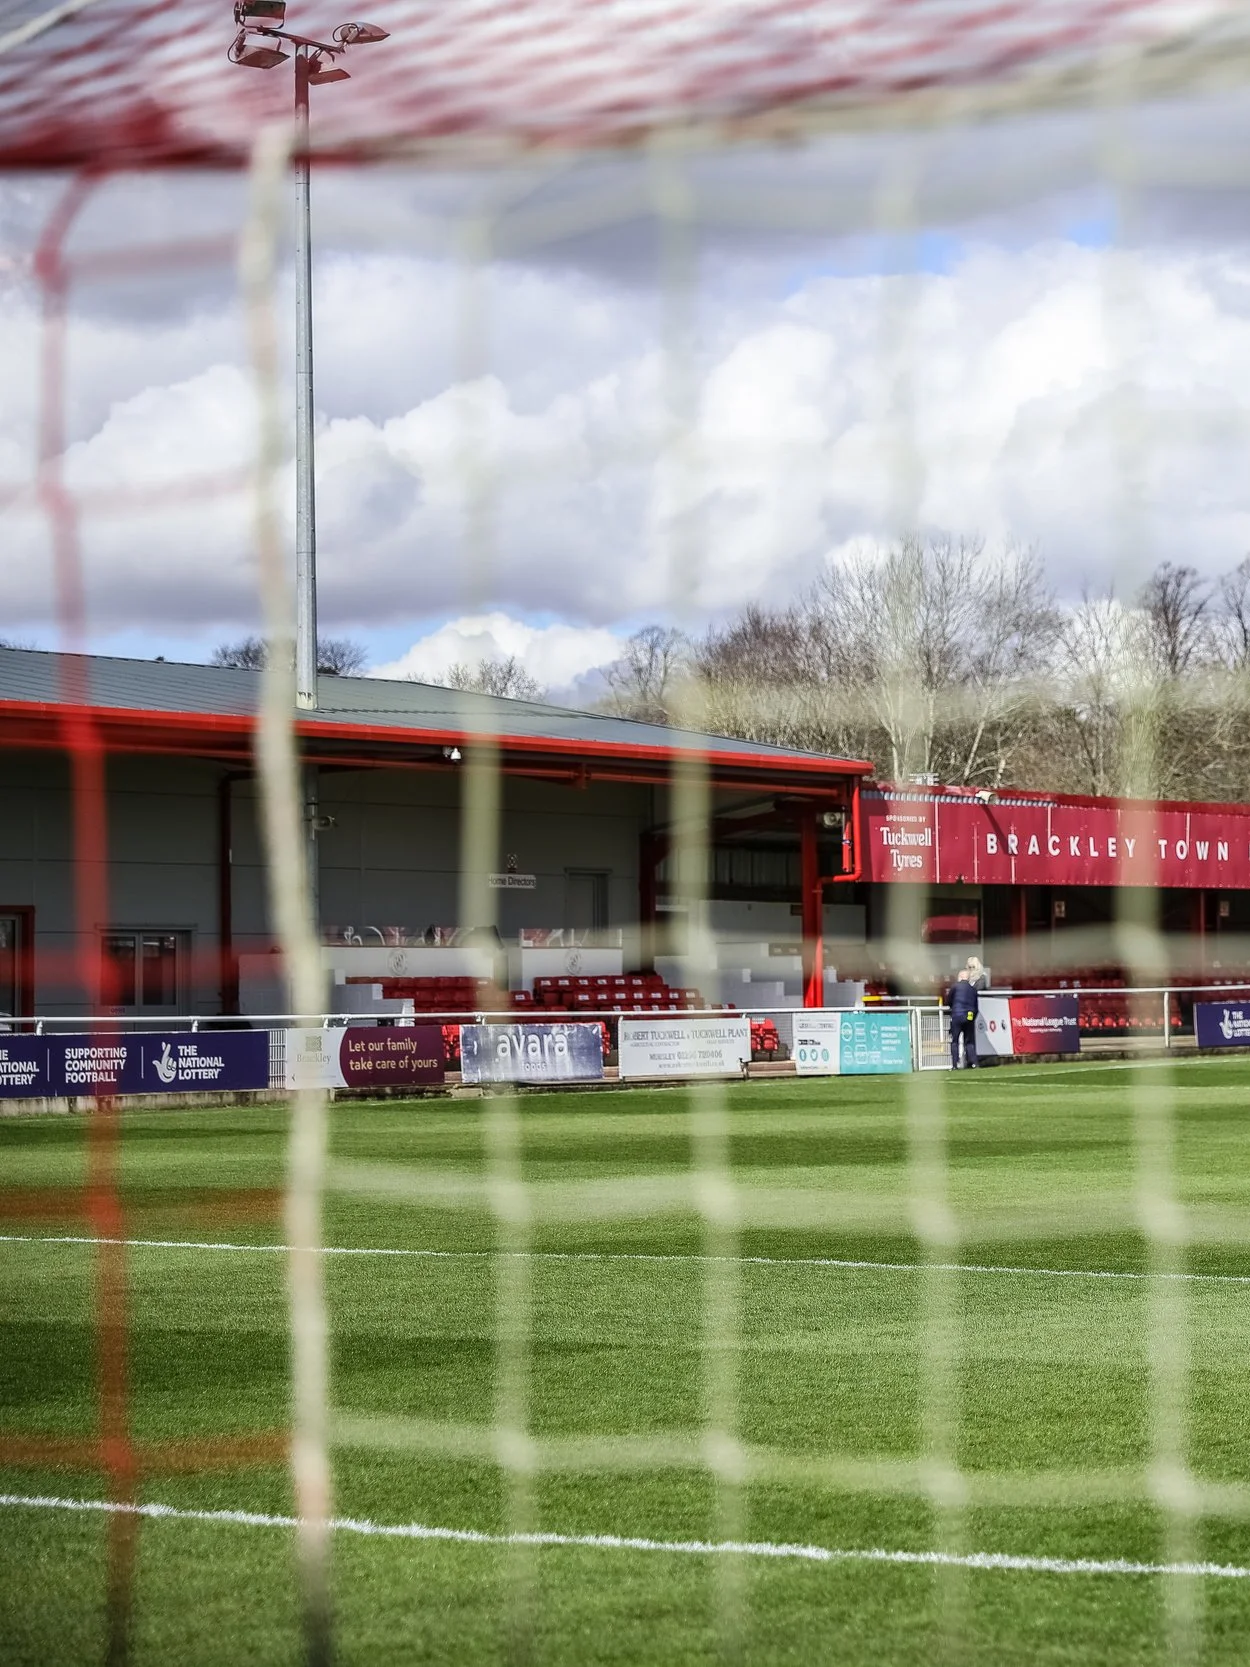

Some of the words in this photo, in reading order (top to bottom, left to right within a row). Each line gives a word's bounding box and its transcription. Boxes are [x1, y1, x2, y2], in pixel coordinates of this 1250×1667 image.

[880, 826, 932, 847] Tuckwell
[986, 833, 1136, 859] BRACKLEY
[1158, 838, 1229, 861] TOWN
[890, 849, 923, 872] Tyres
[727, 1028, 748, 1038] PLANT
[178, 1045, 198, 1056] THE
[348, 1040, 366, 1052] Let
[368, 1042, 385, 1052] our
[386, 1037, 418, 1054] family
[496, 1031, 569, 1057] avara
[64, 1047, 128, 1060] SUPPORTING
[65, 1059, 128, 1072] COMMUNITY
[178, 1056, 225, 1068] NATIONAL
[349, 1057, 374, 1071] take
[375, 1060, 396, 1069] care
[399, 1056, 409, 1069] of
[411, 1059, 439, 1073] yours
[65, 1071, 117, 1084] FOOTBALL
[178, 1068, 220, 1080] LOTTERY
